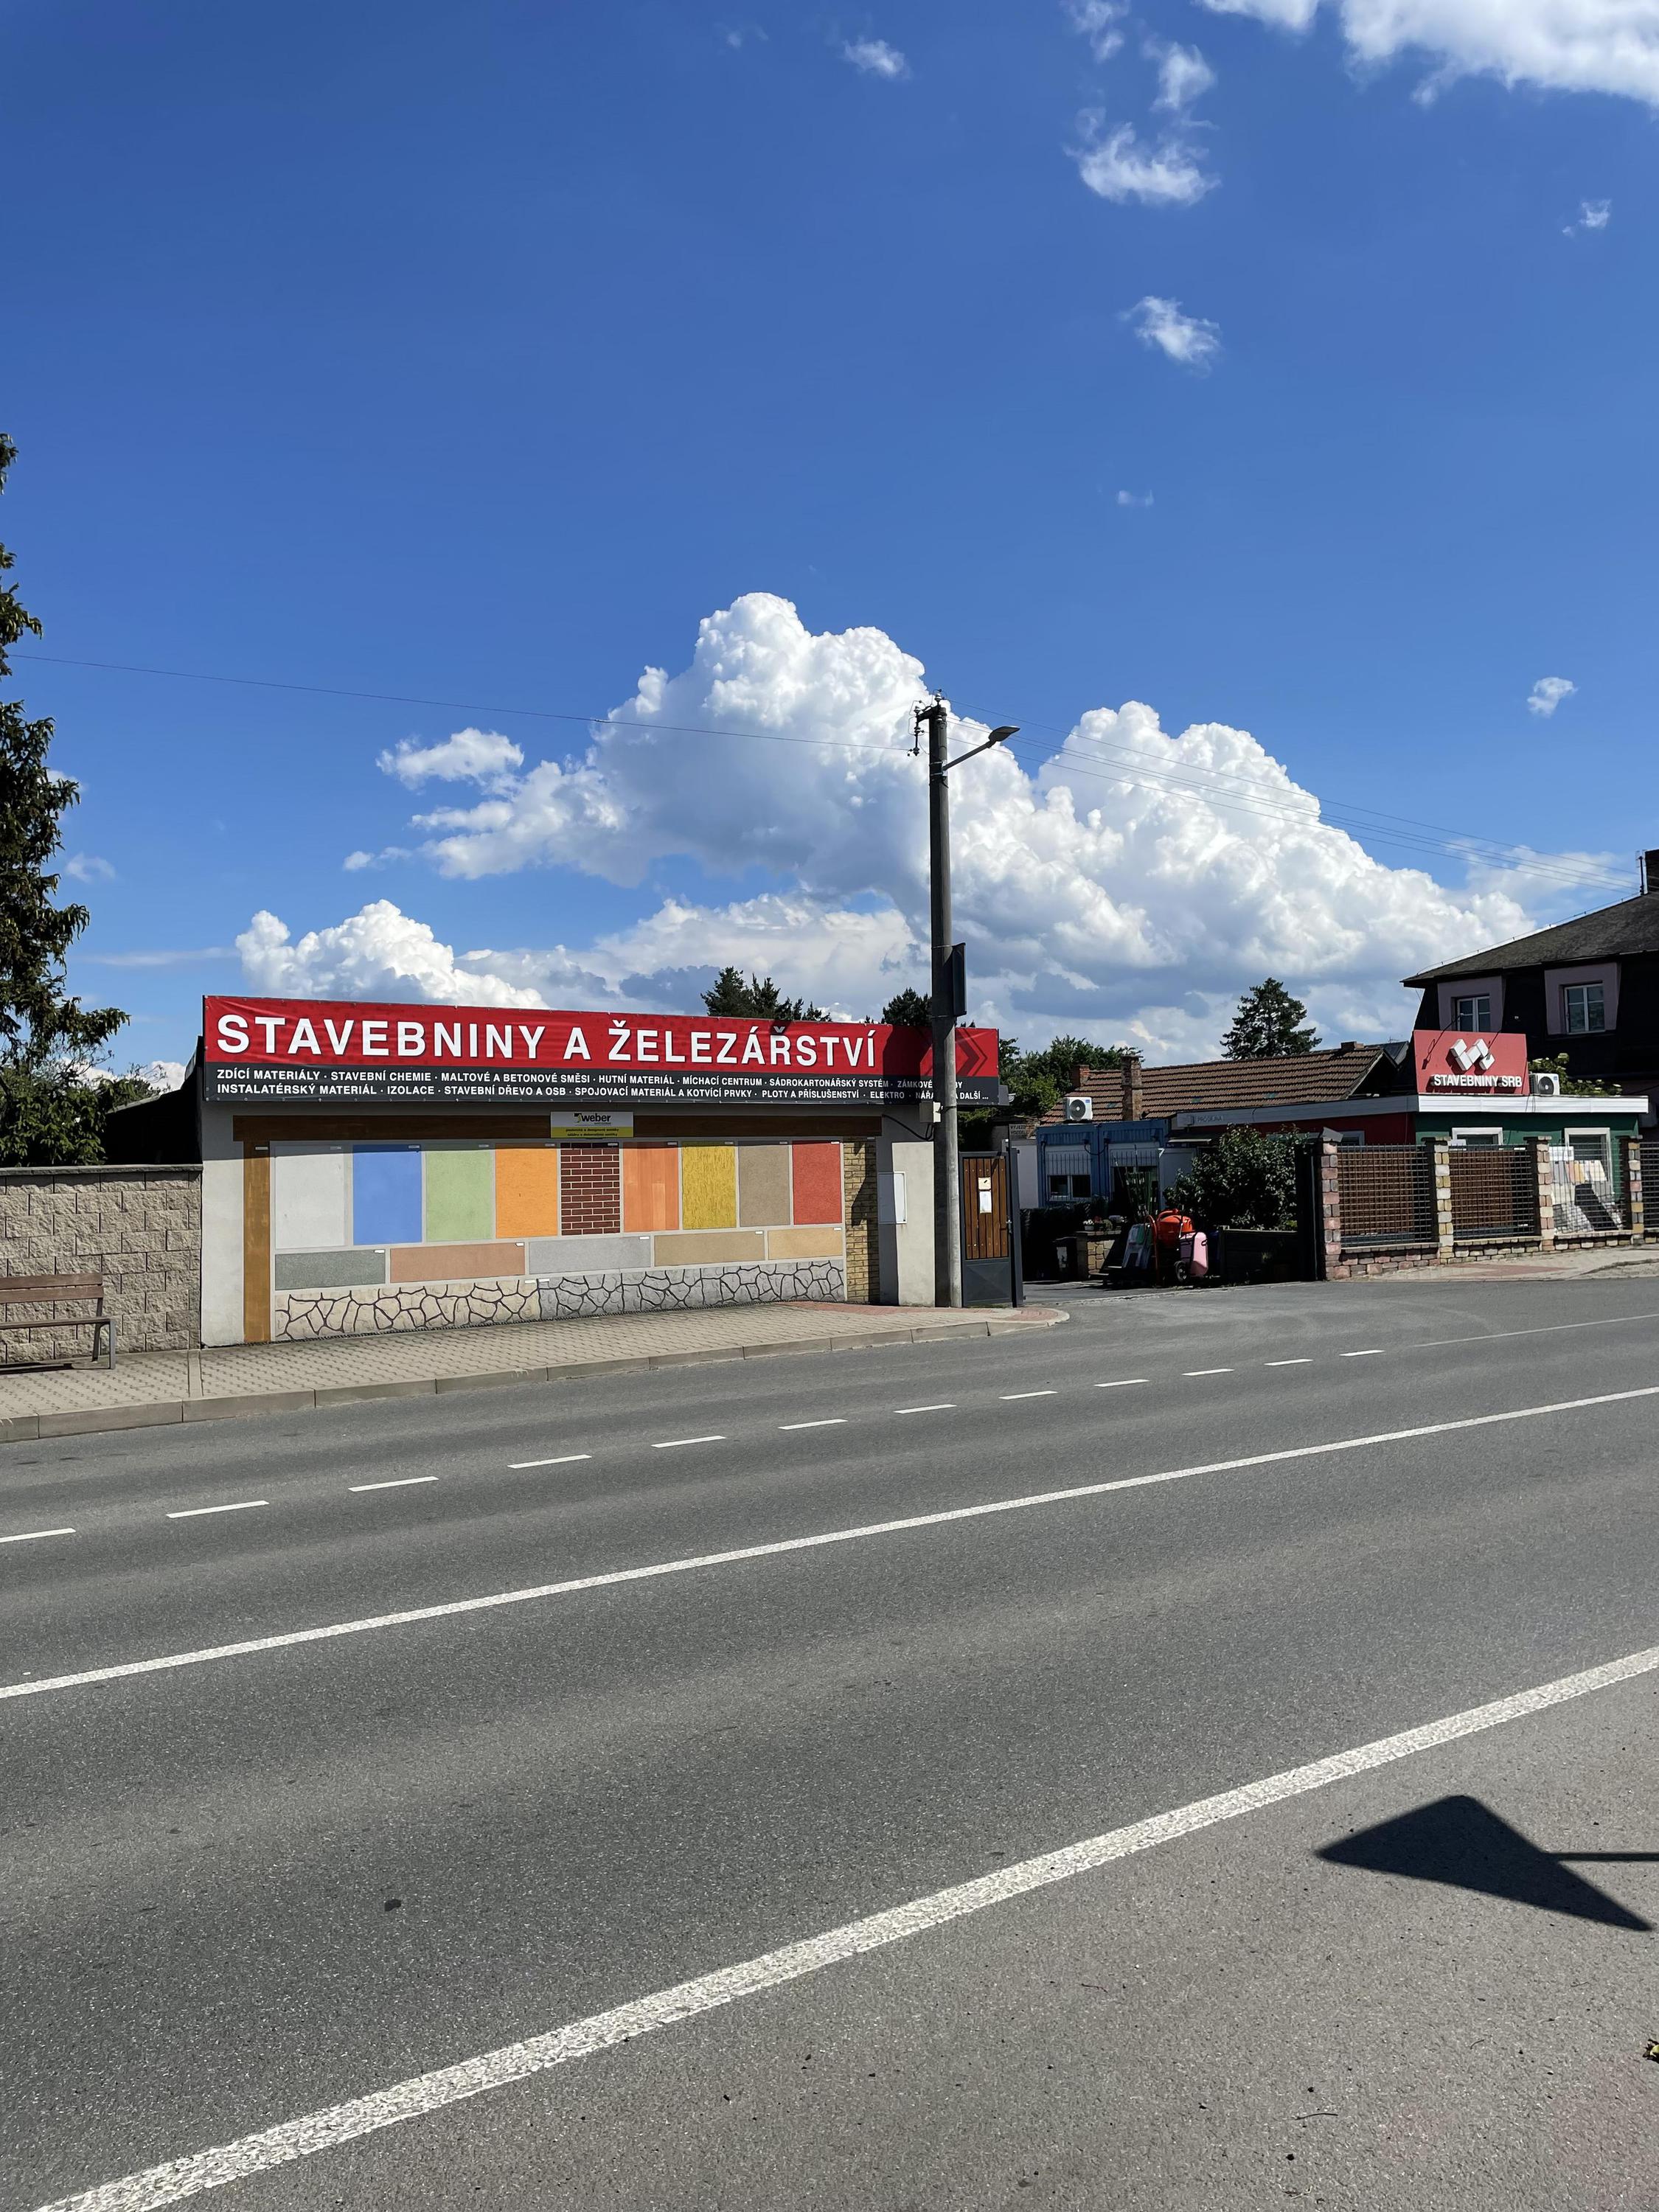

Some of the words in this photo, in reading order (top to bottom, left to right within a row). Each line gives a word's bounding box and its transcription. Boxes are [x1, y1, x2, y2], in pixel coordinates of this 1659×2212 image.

[217, 1014, 545, 1059] STAVEBNINY
[563, 1027, 591, 1060] A
[608, 1020, 876, 1067] ŽELEZÁŘSTVÍ
[217, 1068, 250, 1079] ZDÍCÍ
[254, 1069, 321, 1080] MATERIÁLY
[331, 1070, 386, 1081] STAVEBNÍ
[389, 1072, 431, 1082] CHEMIE
[441, 1071, 490, 1082] MALTOVÉ
[493, 1074, 501, 1082] A
[503, 1073, 558, 1083] BETONOVÉ
[560, 1073, 590, 1084] SMĚSI
[599, 1074, 627, 1084] HUTNÍ
[630, 1074, 675, 1085] MATERIÁL
[682, 1075, 720, 1085] MÍCHACÍ
[721, 1077, 762, 1086] CENTRUM
[769, 1077, 856, 1088] SÁDROKARTONÁŘSKÝ
[858, 1079, 889, 1088] SYSTÉM
[897, 1079, 933, 1088] ZÁMKOVÉ
[1433, 1074, 1499, 1087] STAVEBNINY
[1501, 1076, 1523, 1088] SRB
[217, 1083, 316, 1094] INSTALATÉRSKÝ
[319, 1084, 377, 1095] MATERIÁL
[387, 1085, 434, 1095] IZOLACE
[444, 1085, 495, 1095] STAVEBNÍ
[498, 1085, 533, 1096] DŘEVO
[535, 1087, 543, 1096] A
[545, 1087, 566, 1096] OSB
[574, 1086, 628, 1096] SPOJOVACÍ
[630, 1087, 676, 1097] MATERIÁL
[678, 1089, 685, 1097] A
[686, 1088, 722, 1097] KOTVÍCÍ
[724, 1089, 752, 1097] PRVKY
[798, 1089, 859, 1099] PŘÍSLUŠENSTVÍ
[581, 1113, 611, 1122] weber
